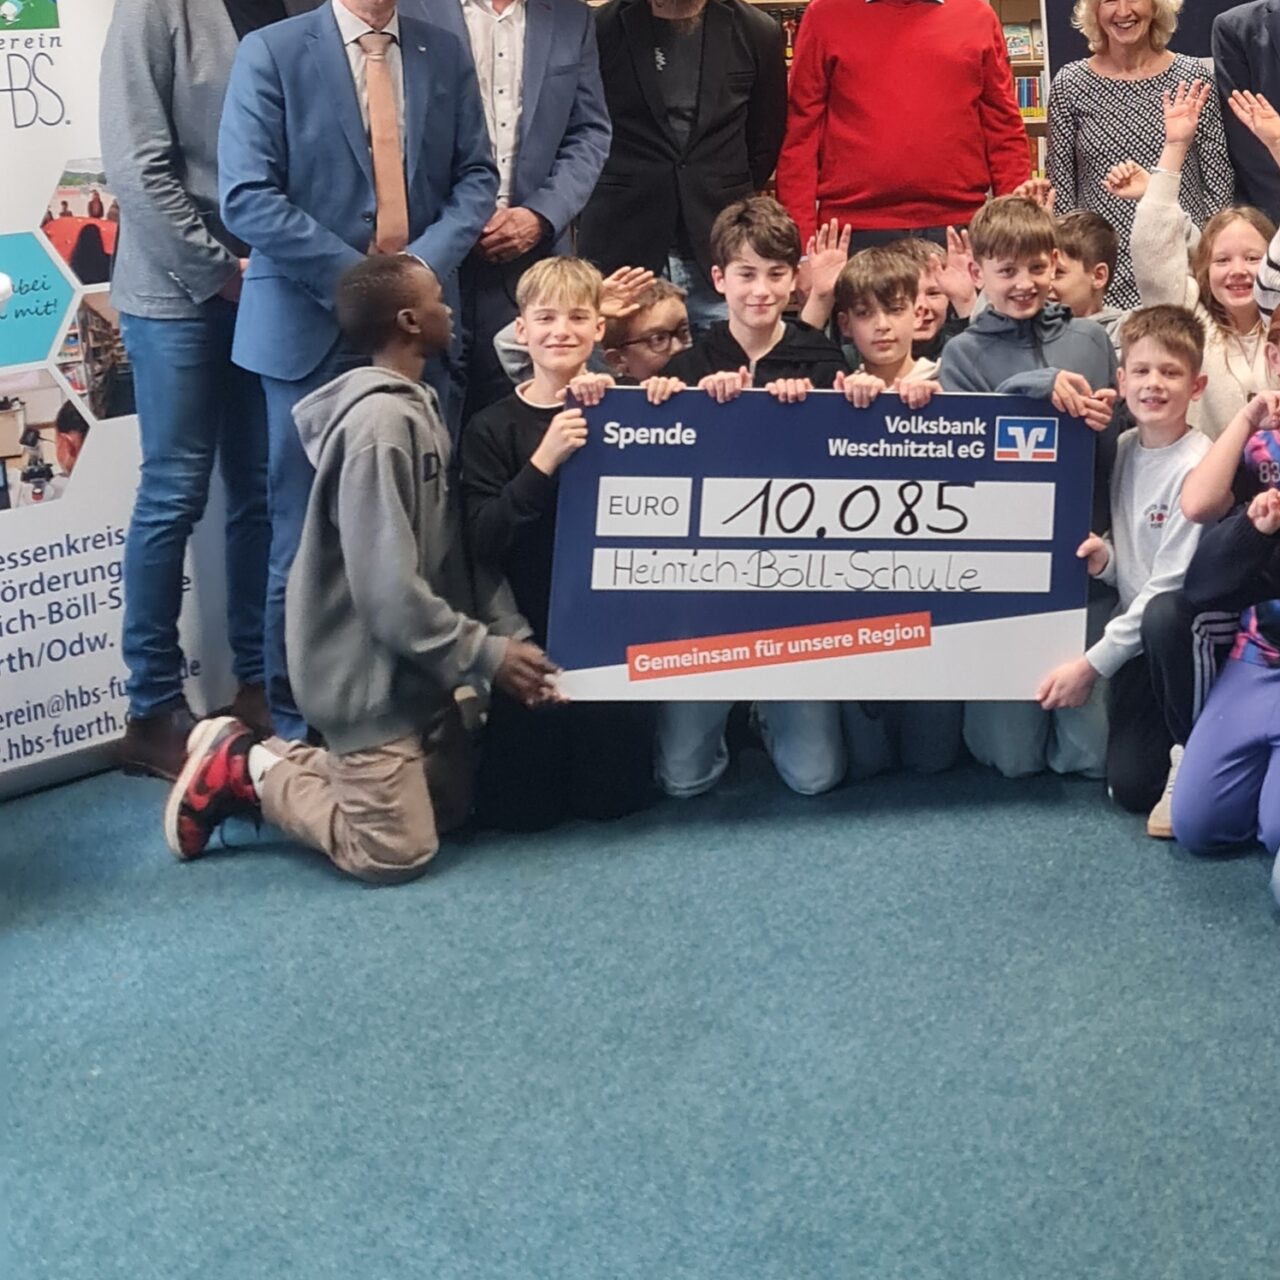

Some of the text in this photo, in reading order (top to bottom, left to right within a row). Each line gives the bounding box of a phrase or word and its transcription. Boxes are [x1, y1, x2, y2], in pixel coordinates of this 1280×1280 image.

[0, 33, 62, 50] erein
[0, 52, 71, 129] BS.
[12, 274, 51, 296] bei
[602, 421, 697, 450] Spende
[885, 416, 986, 435] Volksbank
[828, 438, 986, 459] Weschnitztal eG
[608, 496, 680, 516] EURO
[722, 479, 976, 539] 10.085
[0, 560, 123, 604] örderung
[613, 549, 983, 592] Heinrich-Böll-Schule
[0, 632, 115, 676] rth/Odw.
[633, 623, 926, 672] Gemeinsam für unsere Region
[0, 711, 132, 764] .hbs-fuerth.
